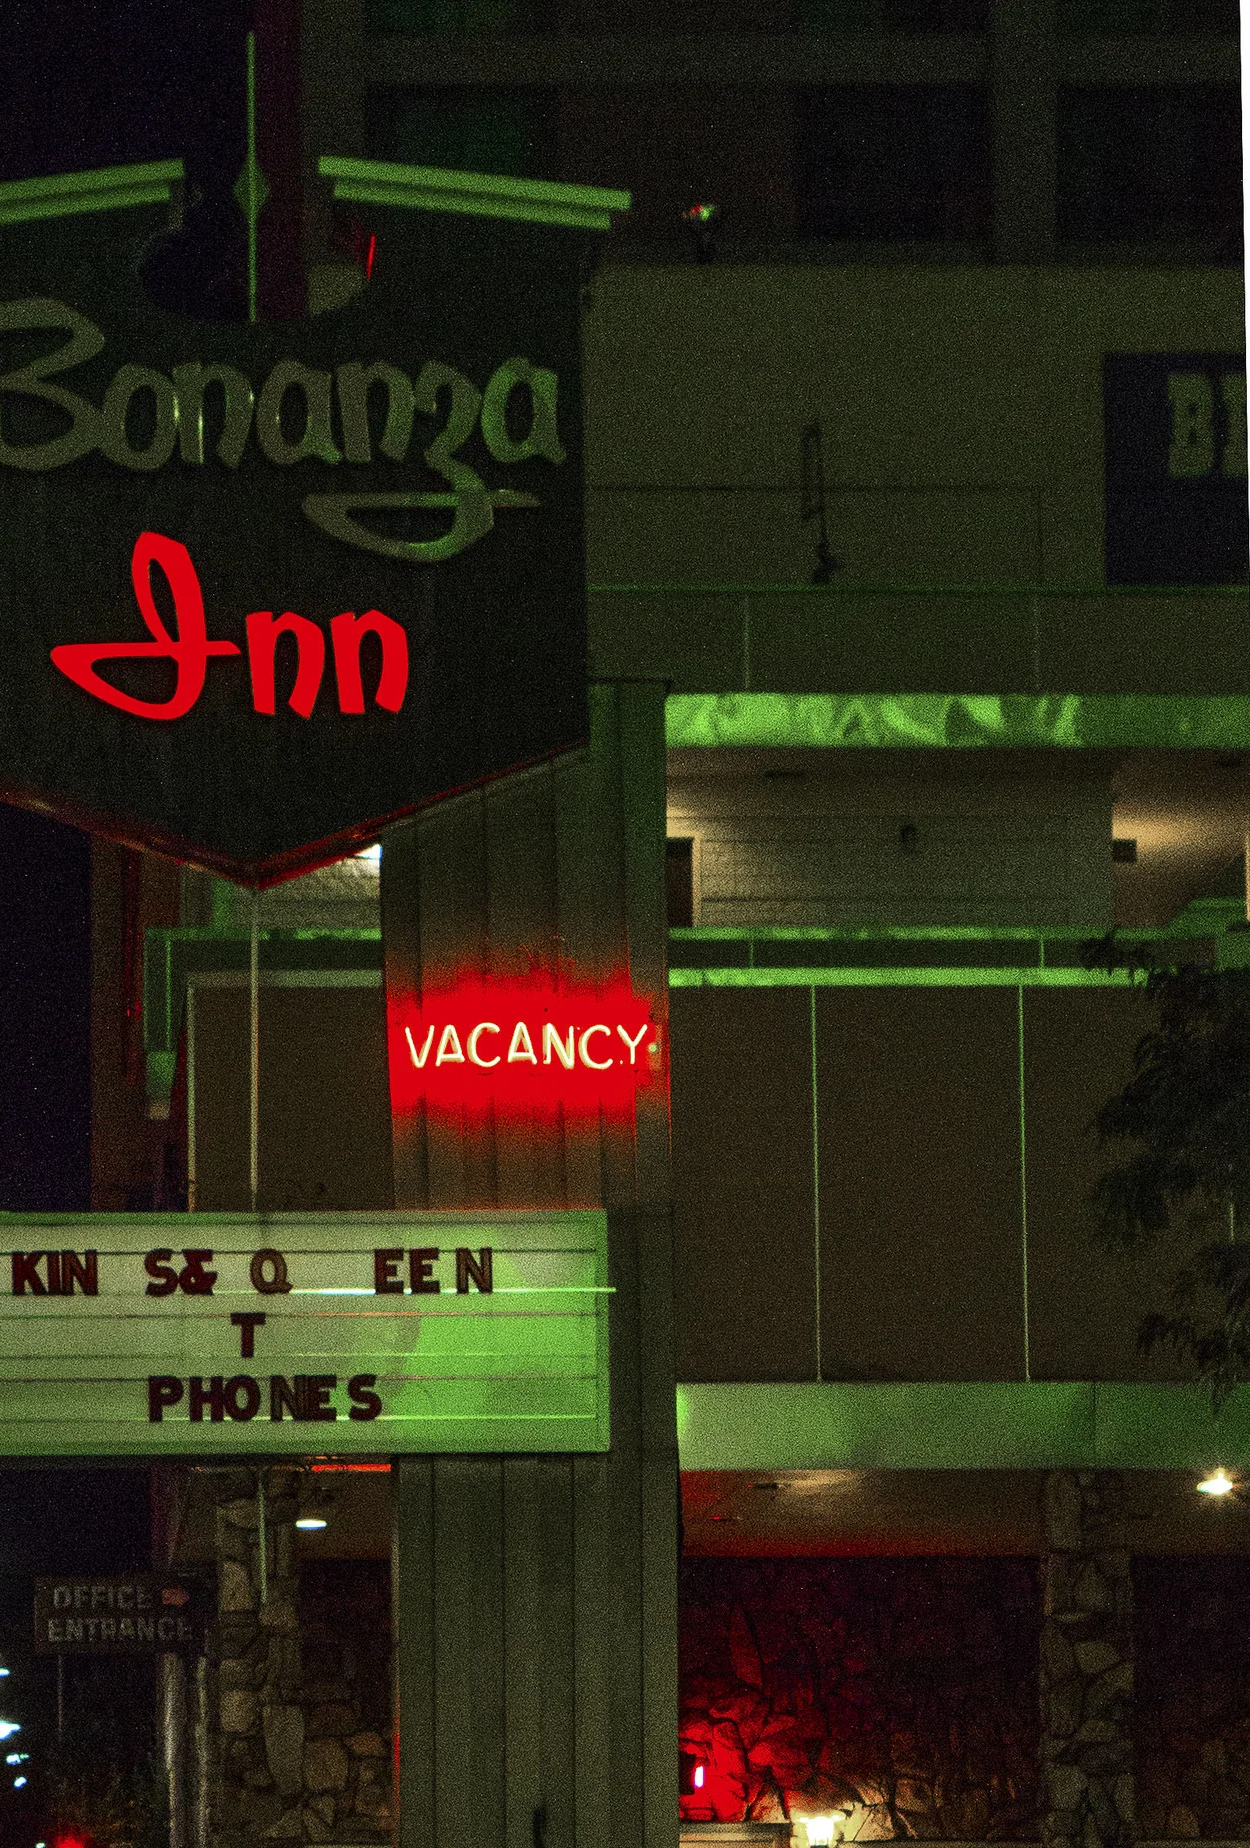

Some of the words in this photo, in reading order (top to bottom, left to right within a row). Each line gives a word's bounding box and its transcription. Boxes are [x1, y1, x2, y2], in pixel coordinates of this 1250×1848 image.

[51, 531, 409, 720] Inn
[403, 1021, 648, 1070] VACANCY
[10, 1250, 99, 1297] KIN
[250, 1248, 295, 1296] Q
[231, 1311, 267, 1359] T
[150, 1373, 384, 1423] PHONES
[53, 1585, 151, 1608] OFFICE
[49, 1617, 193, 1641] ENTRANCE
